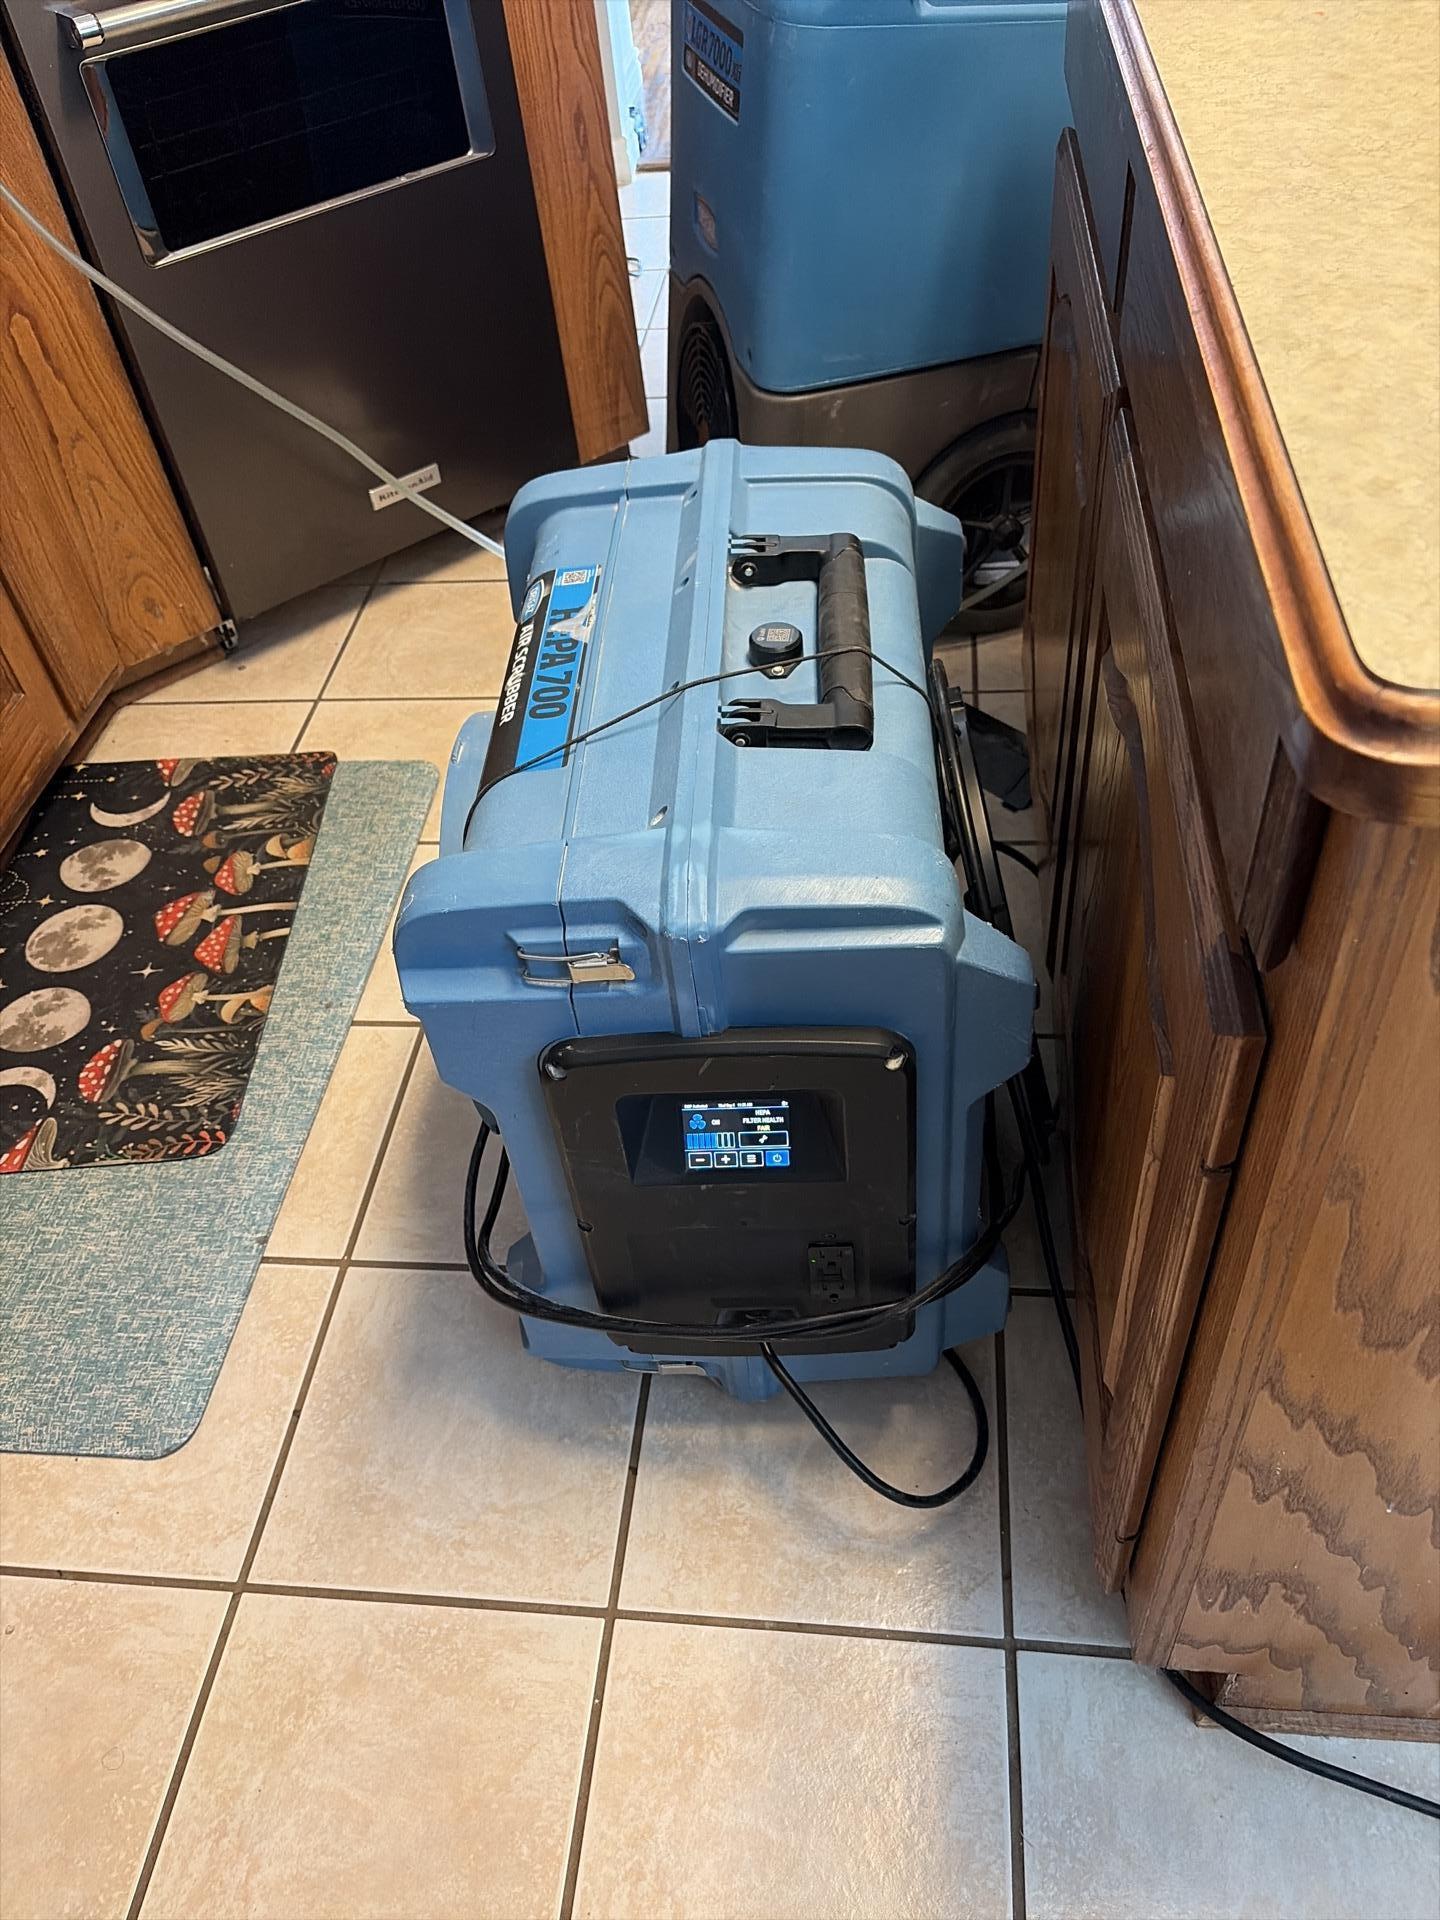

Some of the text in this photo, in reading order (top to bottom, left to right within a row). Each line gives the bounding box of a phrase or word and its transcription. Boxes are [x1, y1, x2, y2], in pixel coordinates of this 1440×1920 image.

[499, 624, 534, 727] AIR SCRUBBER
[529, 670, 573, 720] 700
